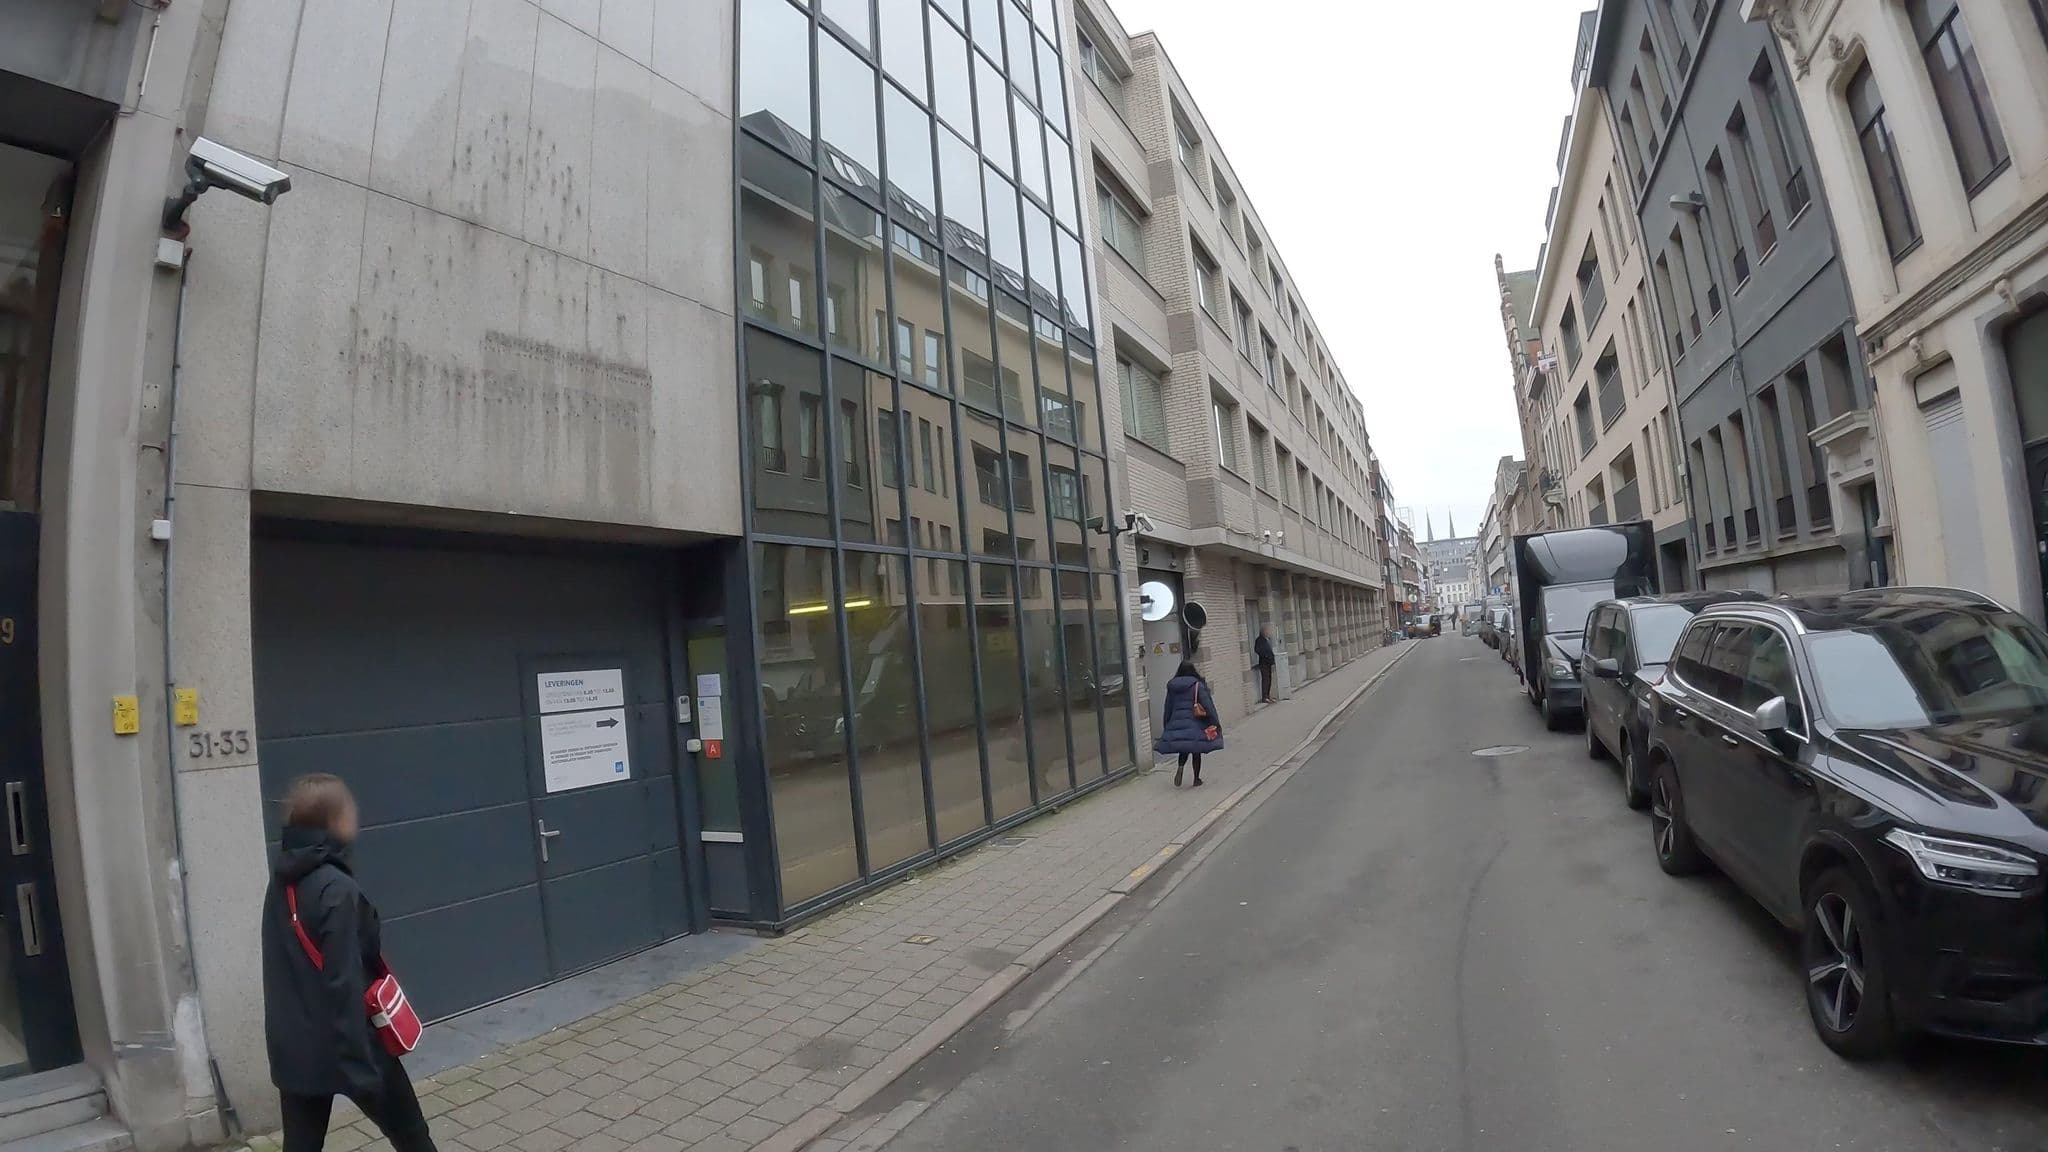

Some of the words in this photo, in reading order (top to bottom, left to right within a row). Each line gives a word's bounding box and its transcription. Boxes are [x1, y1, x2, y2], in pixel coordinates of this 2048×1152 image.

[1, 618, 14, 644] 9
[544, 679, 584, 688] LEVERINGEN
[710, 744, 717, 754] A
